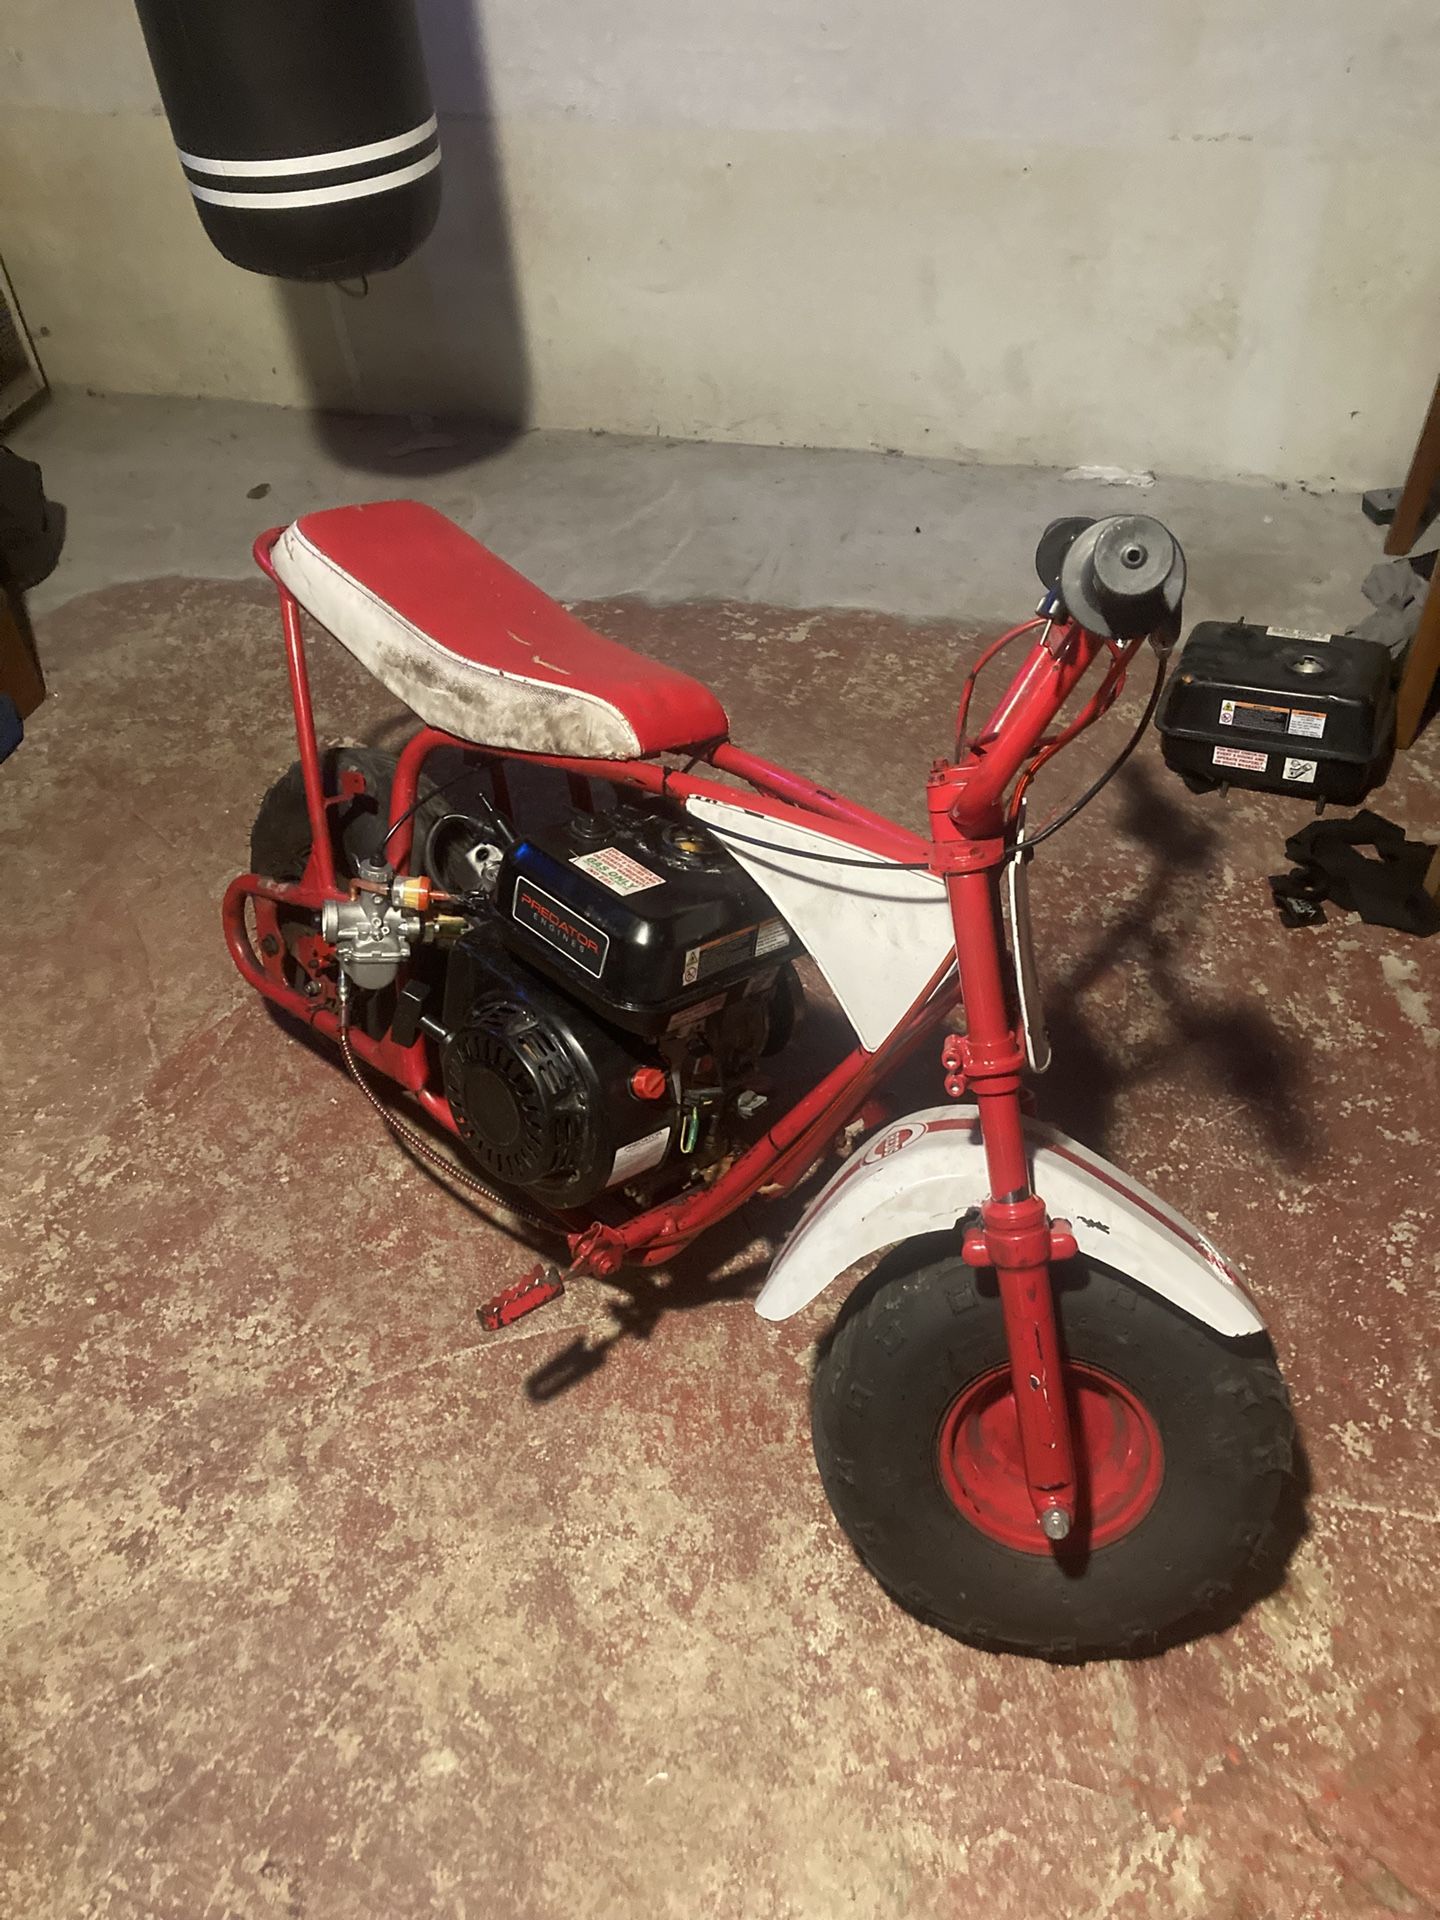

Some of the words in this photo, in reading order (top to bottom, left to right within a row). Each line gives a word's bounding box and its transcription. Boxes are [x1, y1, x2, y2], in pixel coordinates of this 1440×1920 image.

[586, 857, 609, 871] GAS
[608, 871, 638, 888] ONLY
[520, 893, 600, 956] PREDATOR
[533, 912, 585, 953] ENGINES
